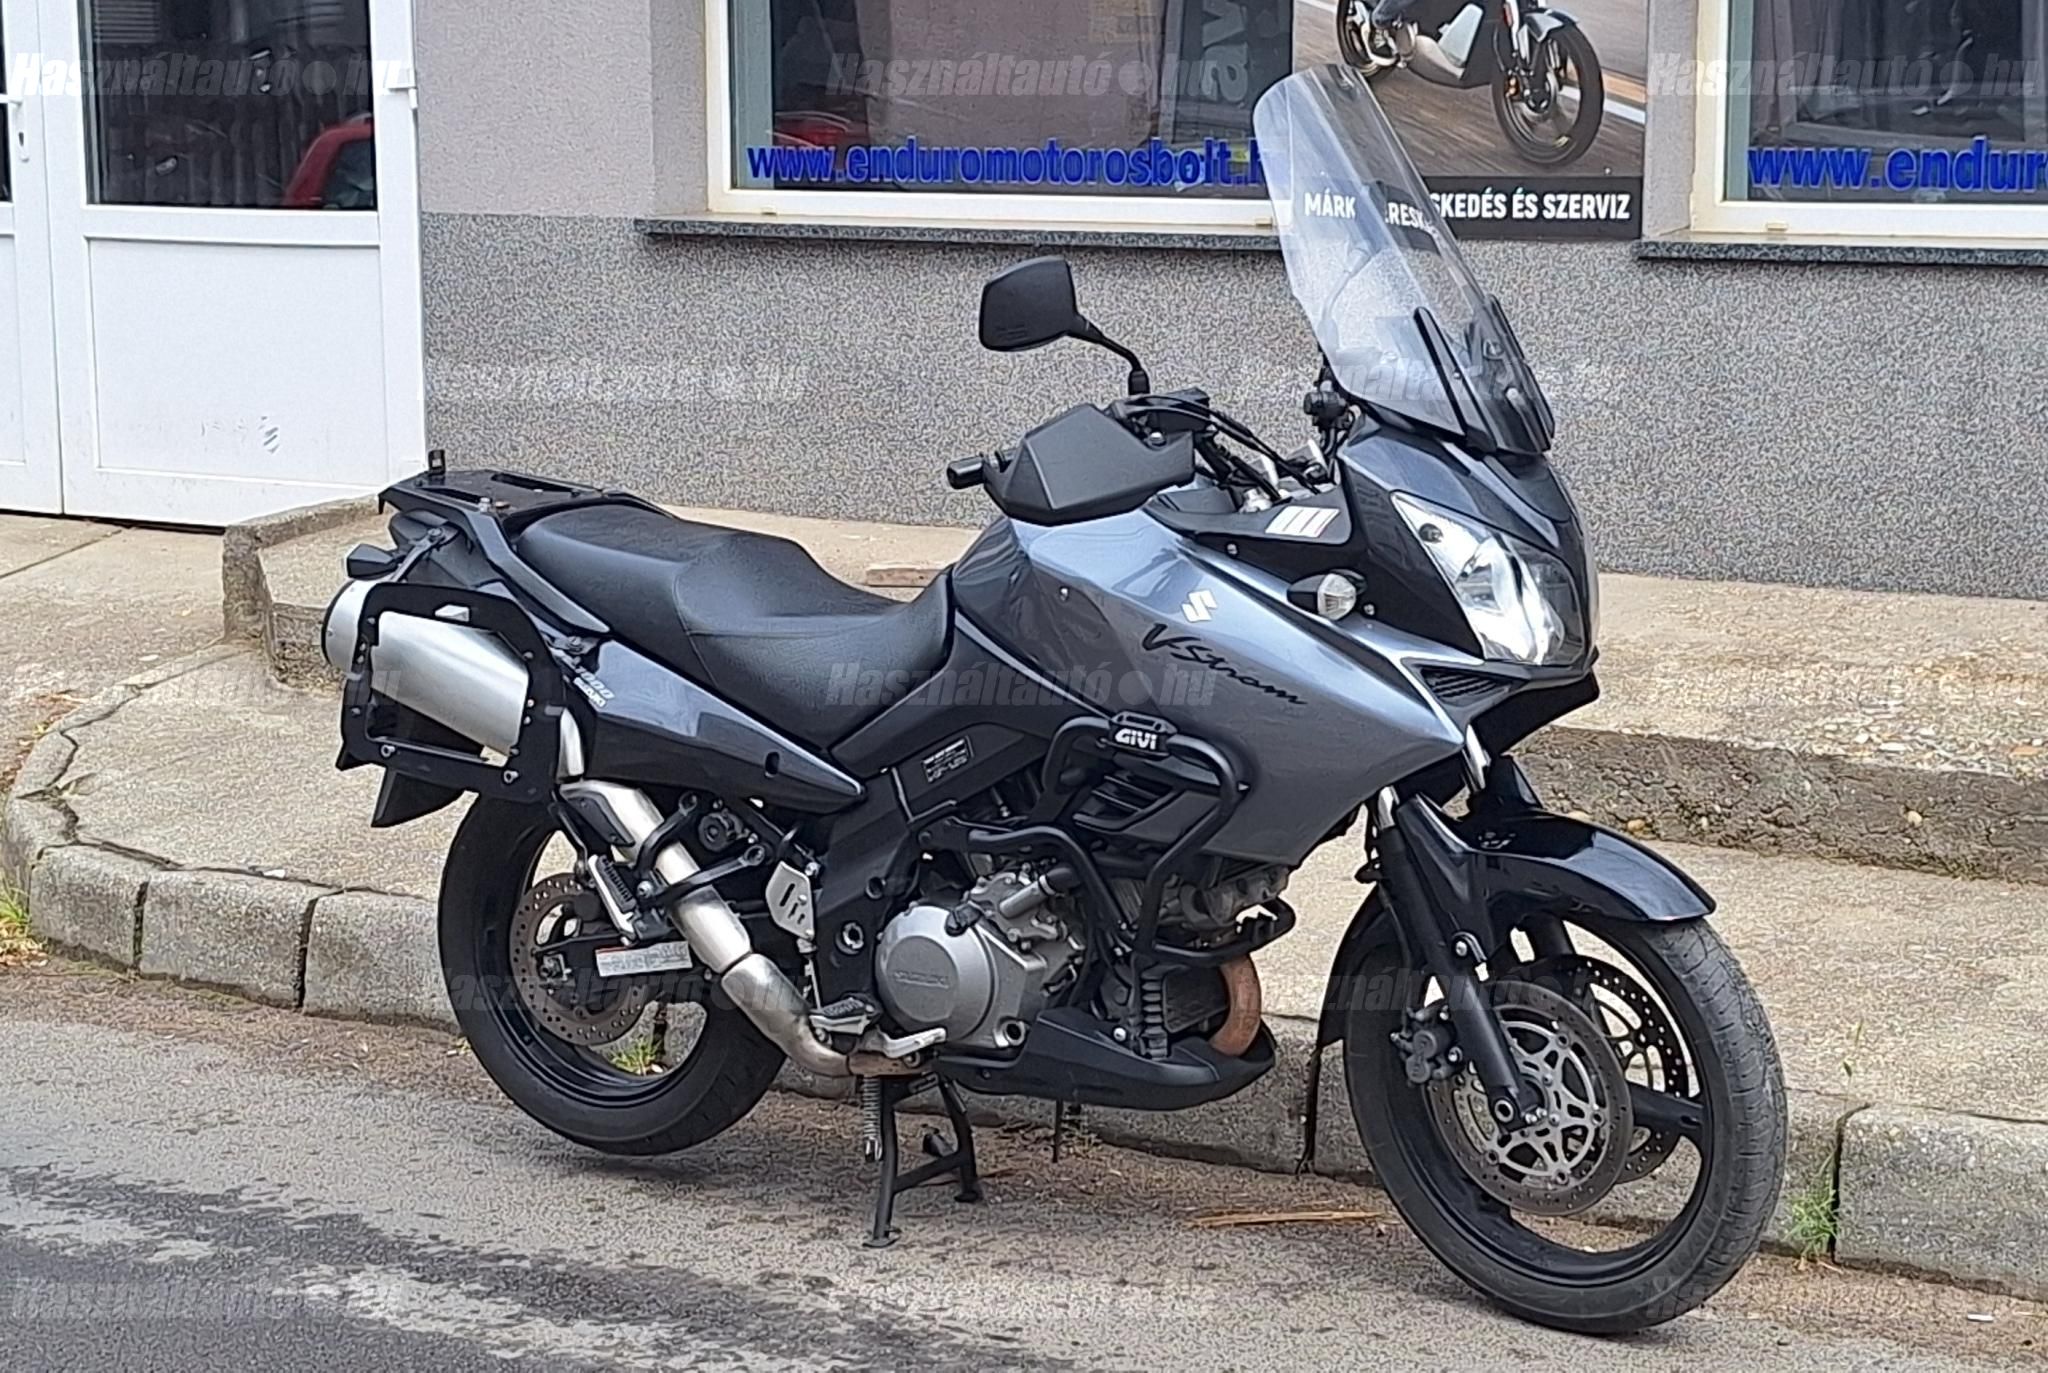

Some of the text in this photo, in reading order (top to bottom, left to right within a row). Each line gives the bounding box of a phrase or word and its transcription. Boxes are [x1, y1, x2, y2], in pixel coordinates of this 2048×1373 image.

[1747, 135, 2048, 194] www.endur
[1512, 187, 1539, 219] ÉS
[1543, 193, 1631, 220] SZERVIZ
